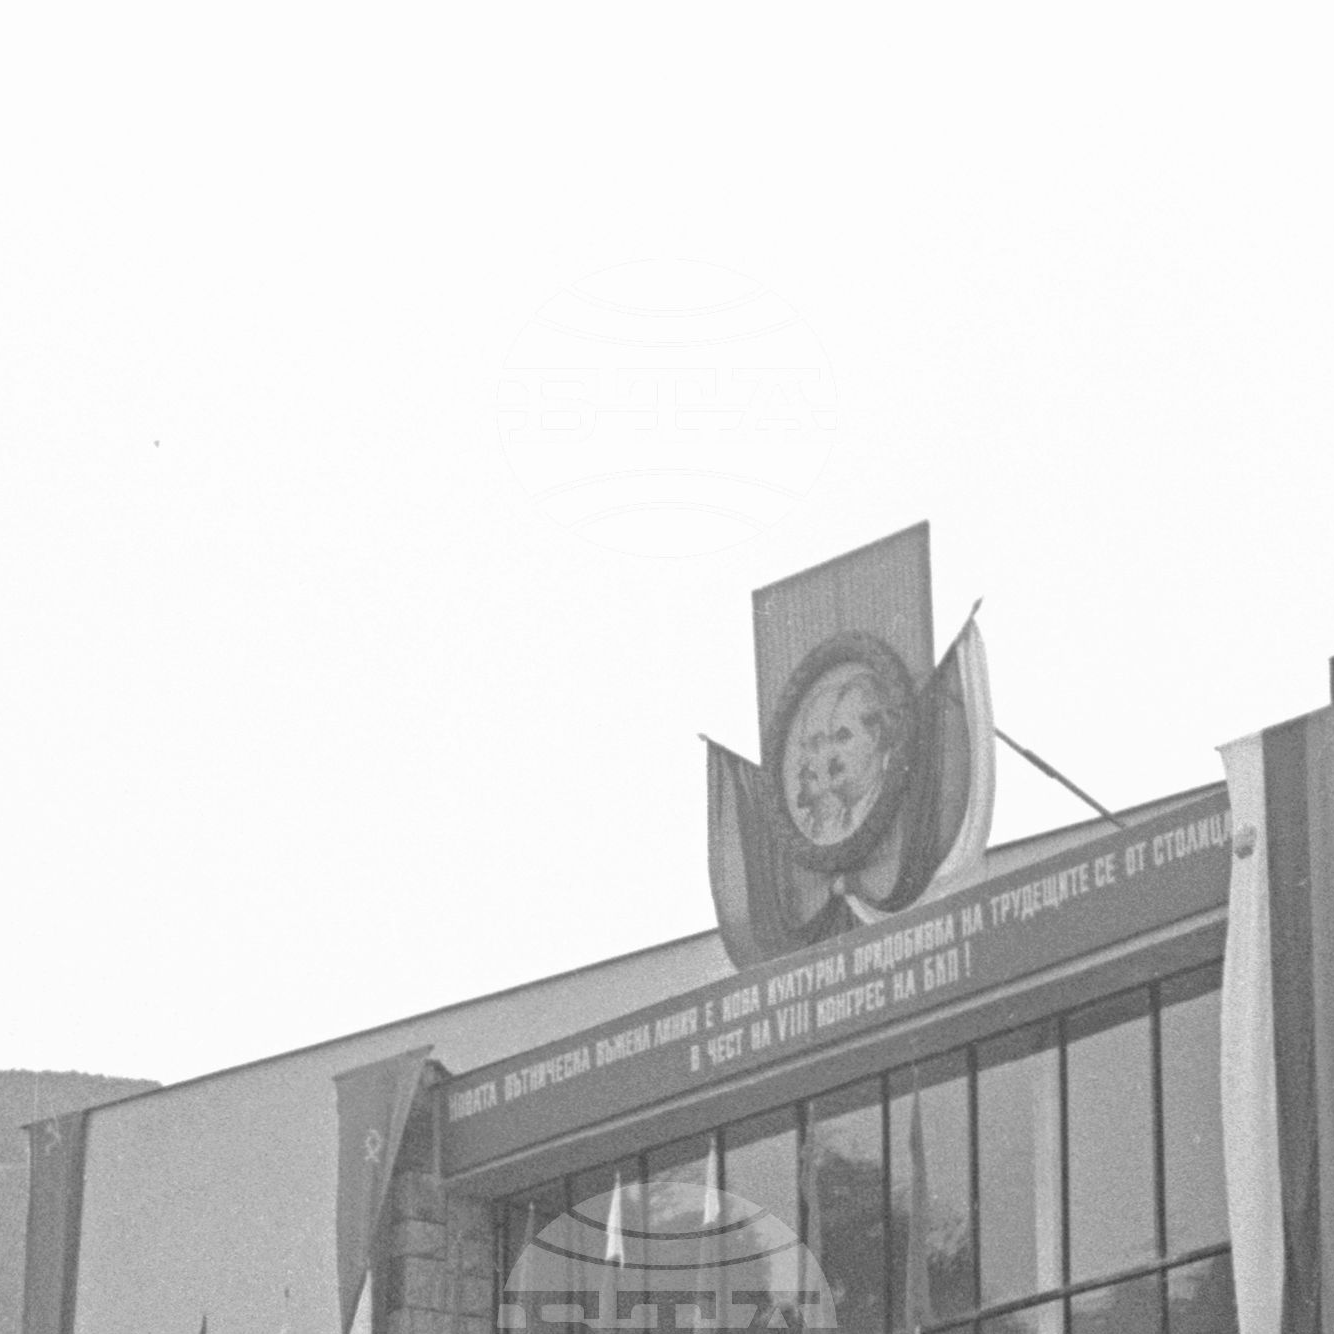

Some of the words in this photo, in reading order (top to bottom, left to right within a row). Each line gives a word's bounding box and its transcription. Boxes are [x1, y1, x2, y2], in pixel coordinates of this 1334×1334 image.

[706, 1000, 714, 1028] Е
[723, 984, 759, 1022] НОВА
[767, 953, 846, 1006] КУЛТУРНА
[853, 914, 954, 975] ПРИДОБИВКА
[962, 903, 983, 937] НА
[990, 863, 1088, 925] ТРУДЕЩИТЕ
[1095, 852, 1115, 887] СЕ
[1126, 841, 1146, 876] ОТ
[690, 1044, 699, 1072] В
[708, 1029, 743, 1065] ЧЕСТ
[751, 1019, 770, 1050] НА
[776, 999, 808, 1041] VIII
[817, 980, 885, 1027] КОНГРЕС
[893, 970, 915, 1000] НА
